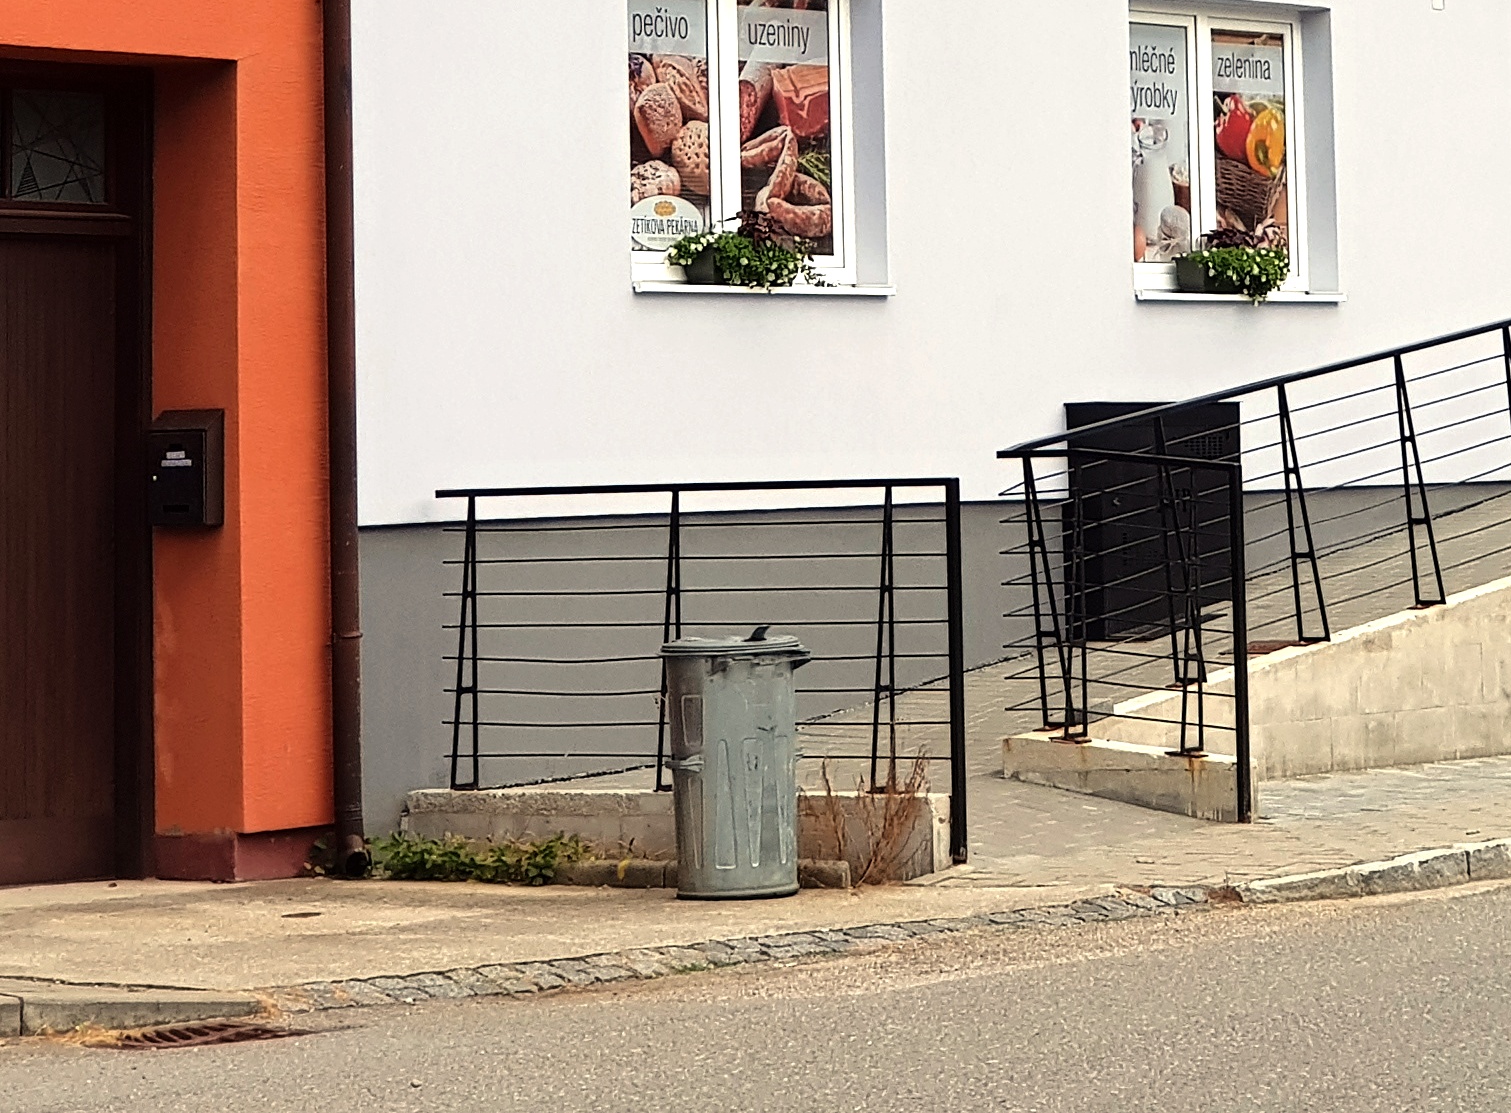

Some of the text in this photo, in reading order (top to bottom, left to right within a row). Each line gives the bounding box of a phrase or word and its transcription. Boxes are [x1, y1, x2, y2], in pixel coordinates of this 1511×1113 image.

[631, 6, 689, 42] pečivo
[748, 18, 810, 55] uzeniny
[1217, 52, 1271, 80] zelenina
[1130, 79, 1178, 116] ýrobky
